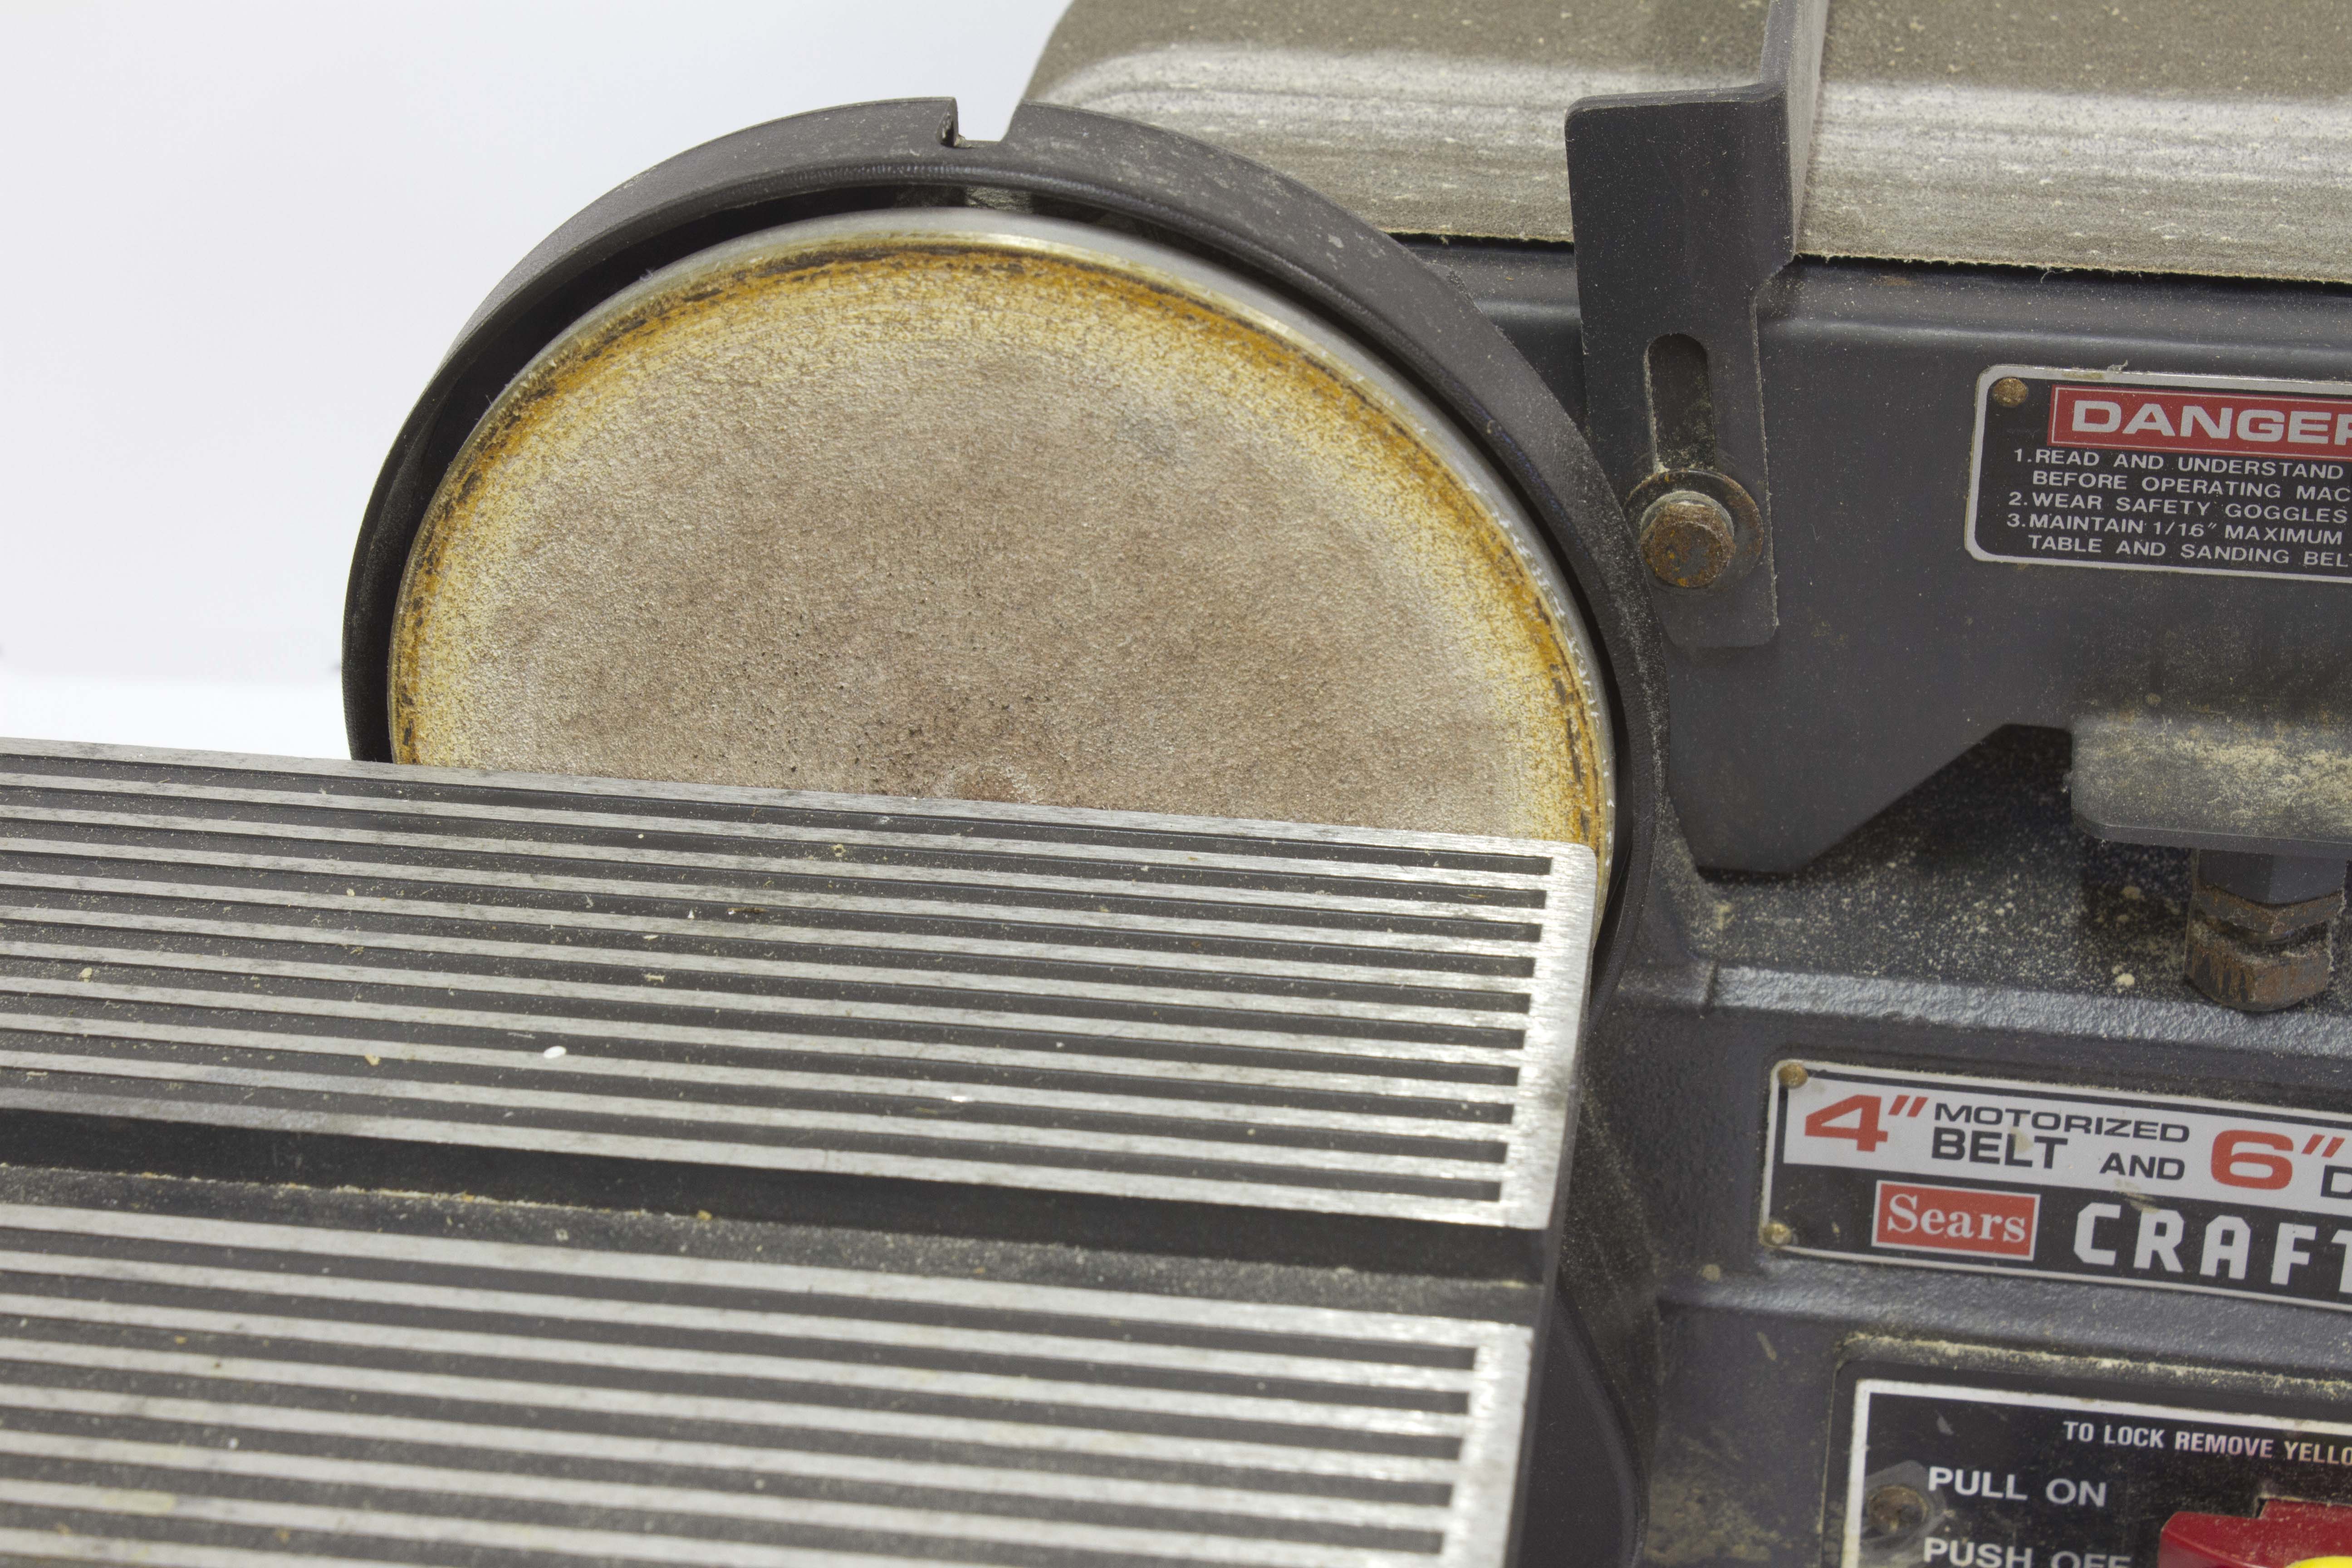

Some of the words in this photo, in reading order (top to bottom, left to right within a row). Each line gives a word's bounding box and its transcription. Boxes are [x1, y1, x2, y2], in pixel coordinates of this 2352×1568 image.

[2113, 453, 2164, 470] AND
[2178, 456, 2343, 479] UNDERSTAND
[2033, 470, 2127, 490] BEFORE
[2141, 476, 2281, 499] OPERATING
[2296, 485, 2351, 502] MAC
[2116, 497, 2210, 516] SAFETY
[2225, 503, 2348, 524] GOGGLES
[2028, 534, 2102, 553] TABLE
[2116, 541, 2166, 557] AND
[2180, 544, 2289, 564] SANDING
[2303, 551, 2352, 567] BEL
[2225, 524, 2342, 545] MAXIMUM
[1935, 1102, 2190, 1143] MOTORIZED
[1931, 1127, 2068, 1170] BELT
[2099, 1152, 2186, 1181] AND
[1886, 1194, 2026, 1243] Sears
[2063, 1421, 2094, 1443] TO
[2104, 1425, 2164, 1449] LOCK
[2175, 1431, 2274, 1459] REMOVE
[2284, 1440, 2352, 1466] YELLO
[1928, 1467, 2027, 1501] PULL
[2045, 1479, 2107, 1508] ON
[1923, 1537, 2033, 1568] PUSH
